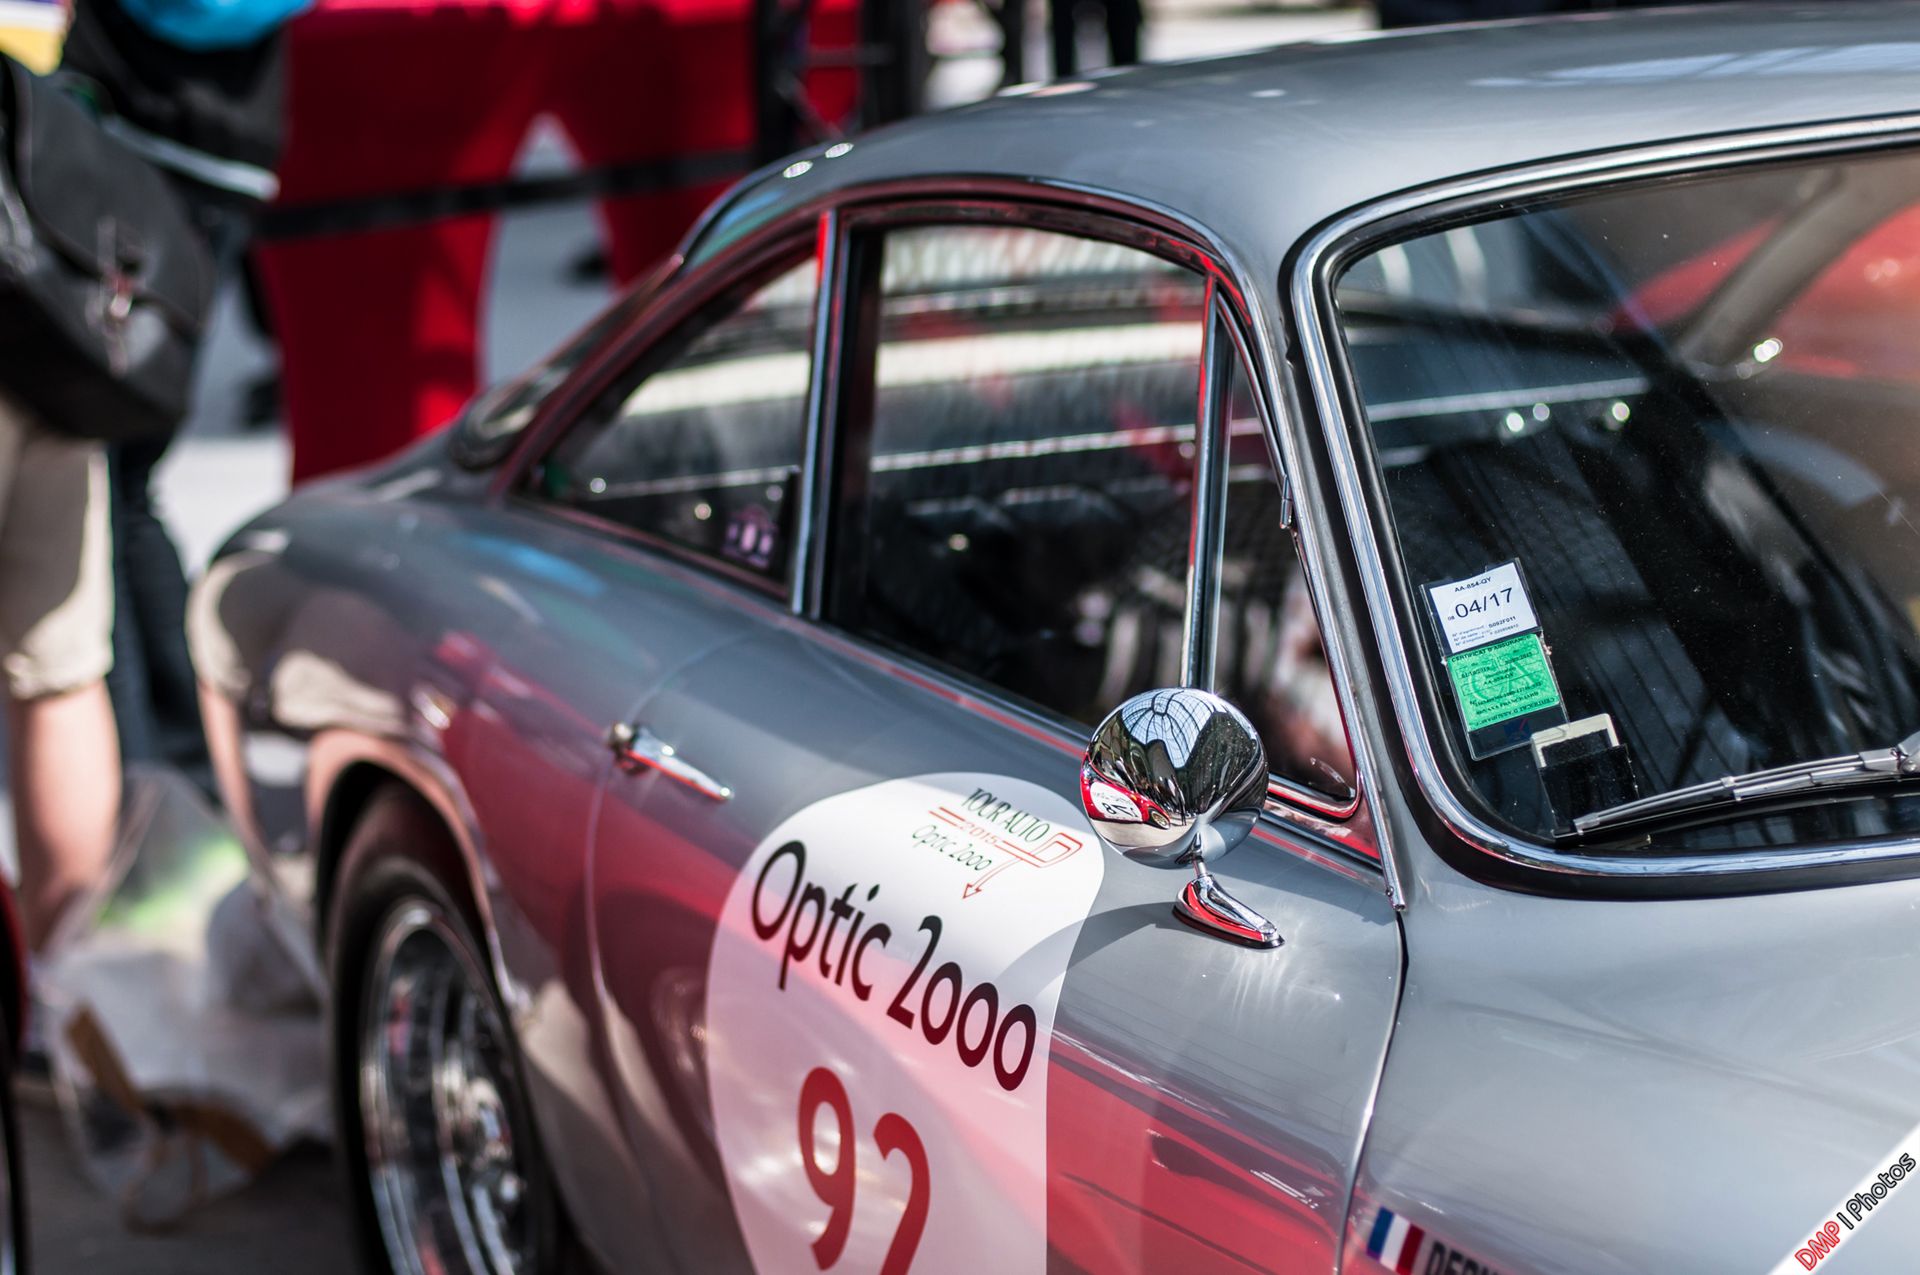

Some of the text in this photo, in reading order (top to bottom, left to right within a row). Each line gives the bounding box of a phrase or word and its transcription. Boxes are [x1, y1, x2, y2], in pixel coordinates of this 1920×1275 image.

[1455, 587, 1513, 618] 04/17
[961, 787, 1050, 843] TOUR AUTO
[912, 824, 992, 871] Optic 2000
[751, 840, 1036, 1091] Optic 2000
[797, 1066, 931, 1275] 92
